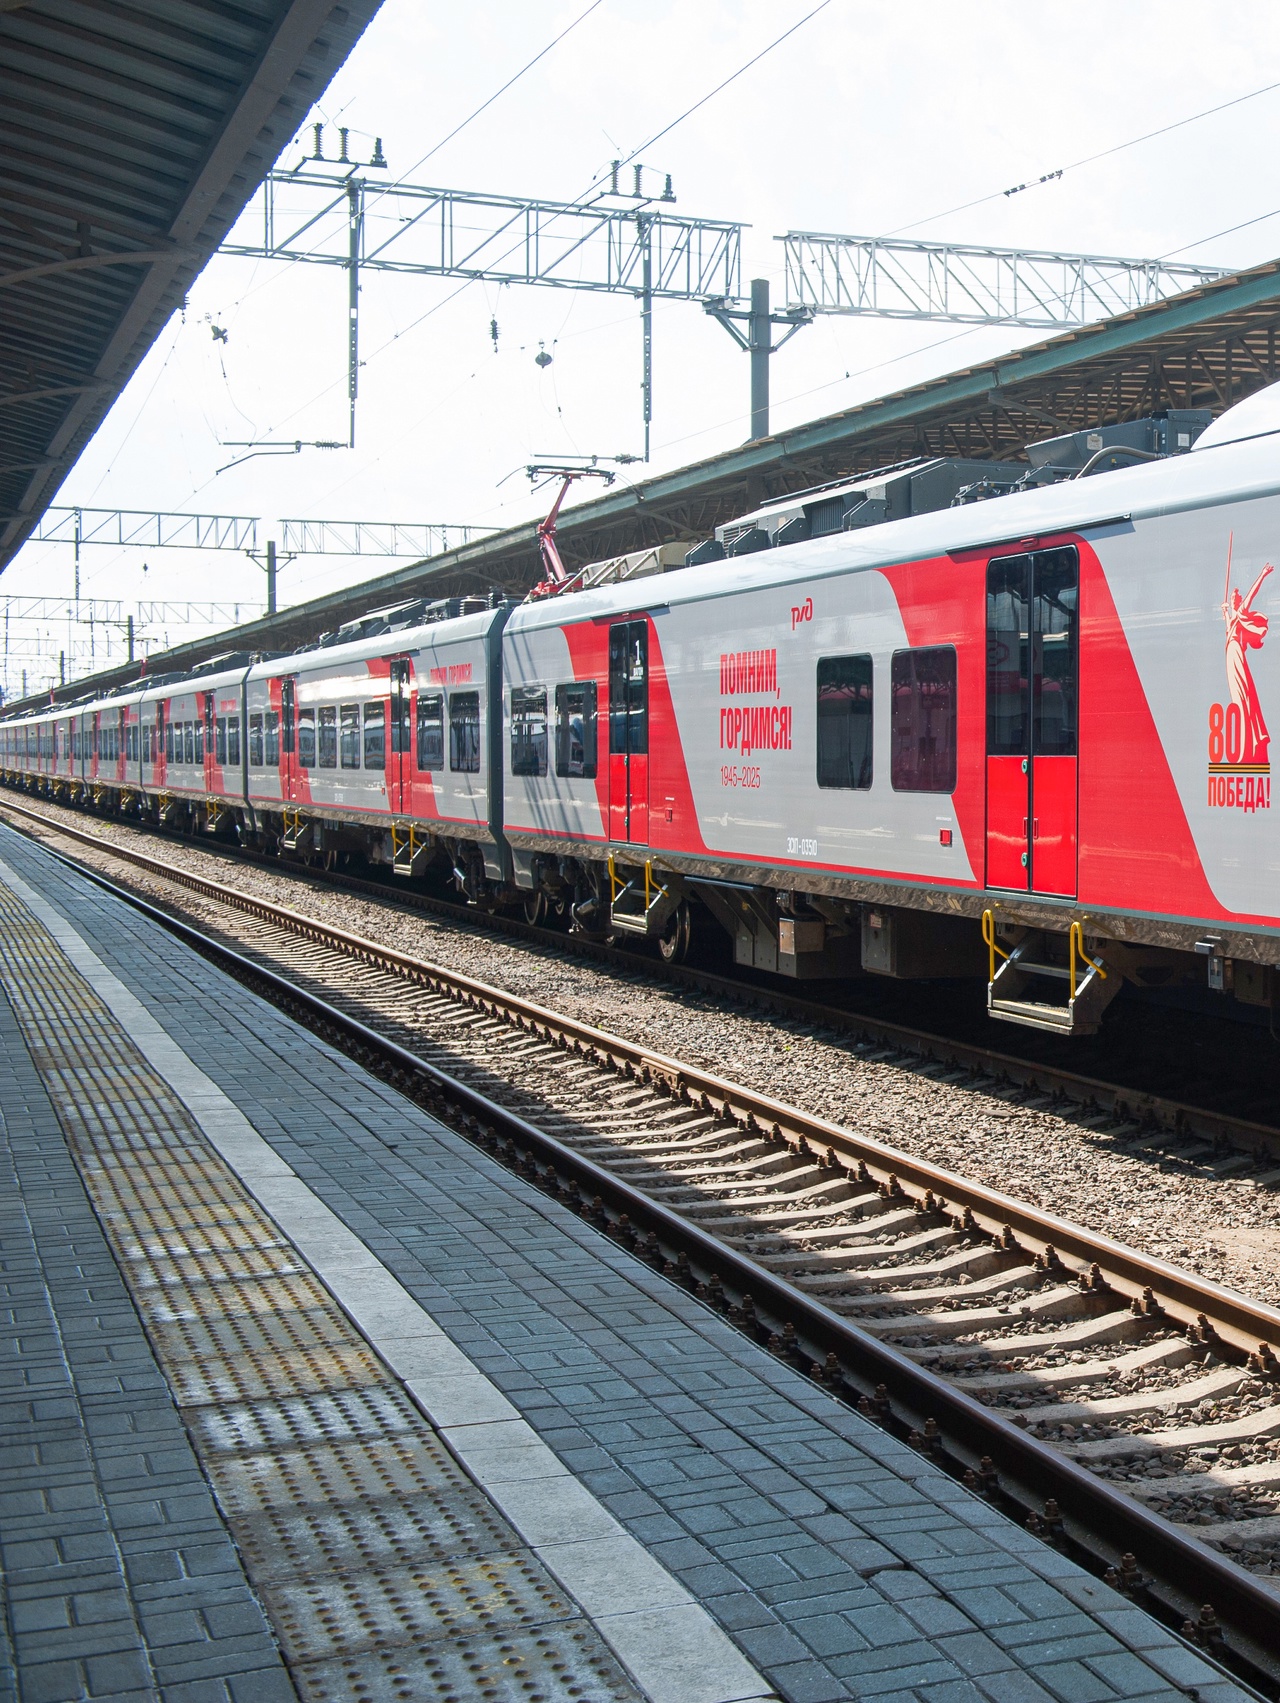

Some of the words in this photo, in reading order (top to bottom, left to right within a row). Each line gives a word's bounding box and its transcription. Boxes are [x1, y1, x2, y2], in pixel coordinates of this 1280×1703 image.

[720, 648, 781, 699] ПОМНИМ,
[720, 706, 793, 756] ГОРДИМСЯ!
[1208, 702, 1241, 764] 80
[1207, 776, 1271, 813] ПОБЕДА!
